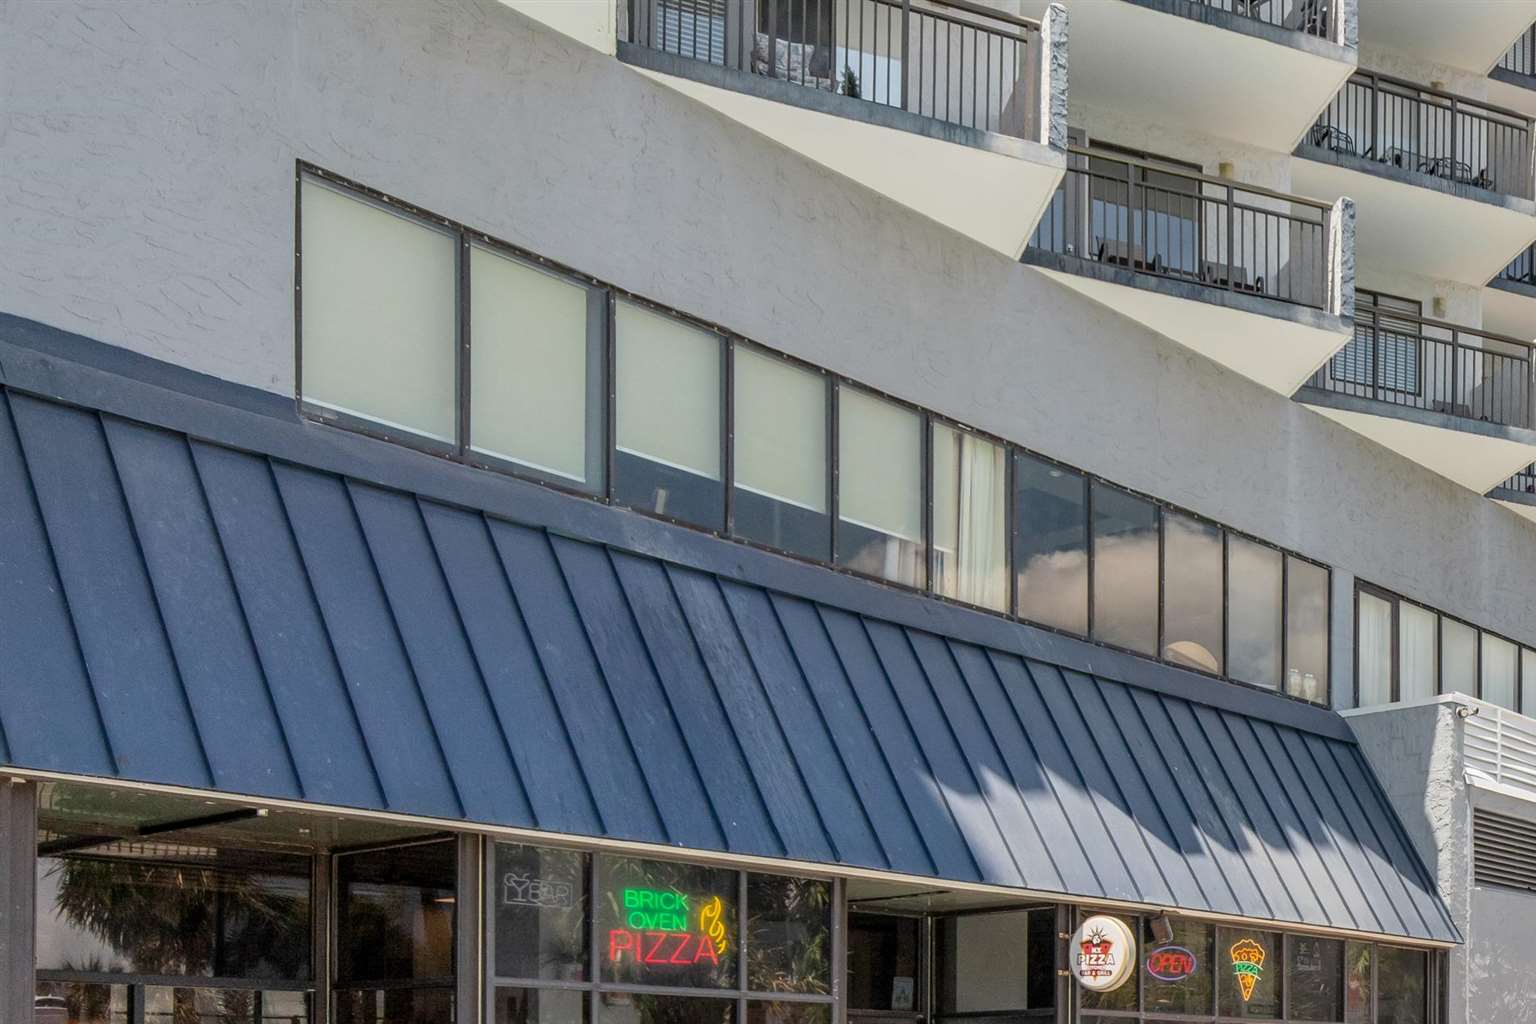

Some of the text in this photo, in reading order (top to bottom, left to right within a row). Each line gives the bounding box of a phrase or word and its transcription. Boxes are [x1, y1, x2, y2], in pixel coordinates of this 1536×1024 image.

[624, 889, 689, 911] BRICK
[628, 911, 687, 931] OVEN
[609, 929, 719, 966] PIZZA
[1077, 953, 1115, 966] PIZZA
[1151, 952, 1193, 975] OPEN
[1235, 963, 1259, 973] PIZZA
